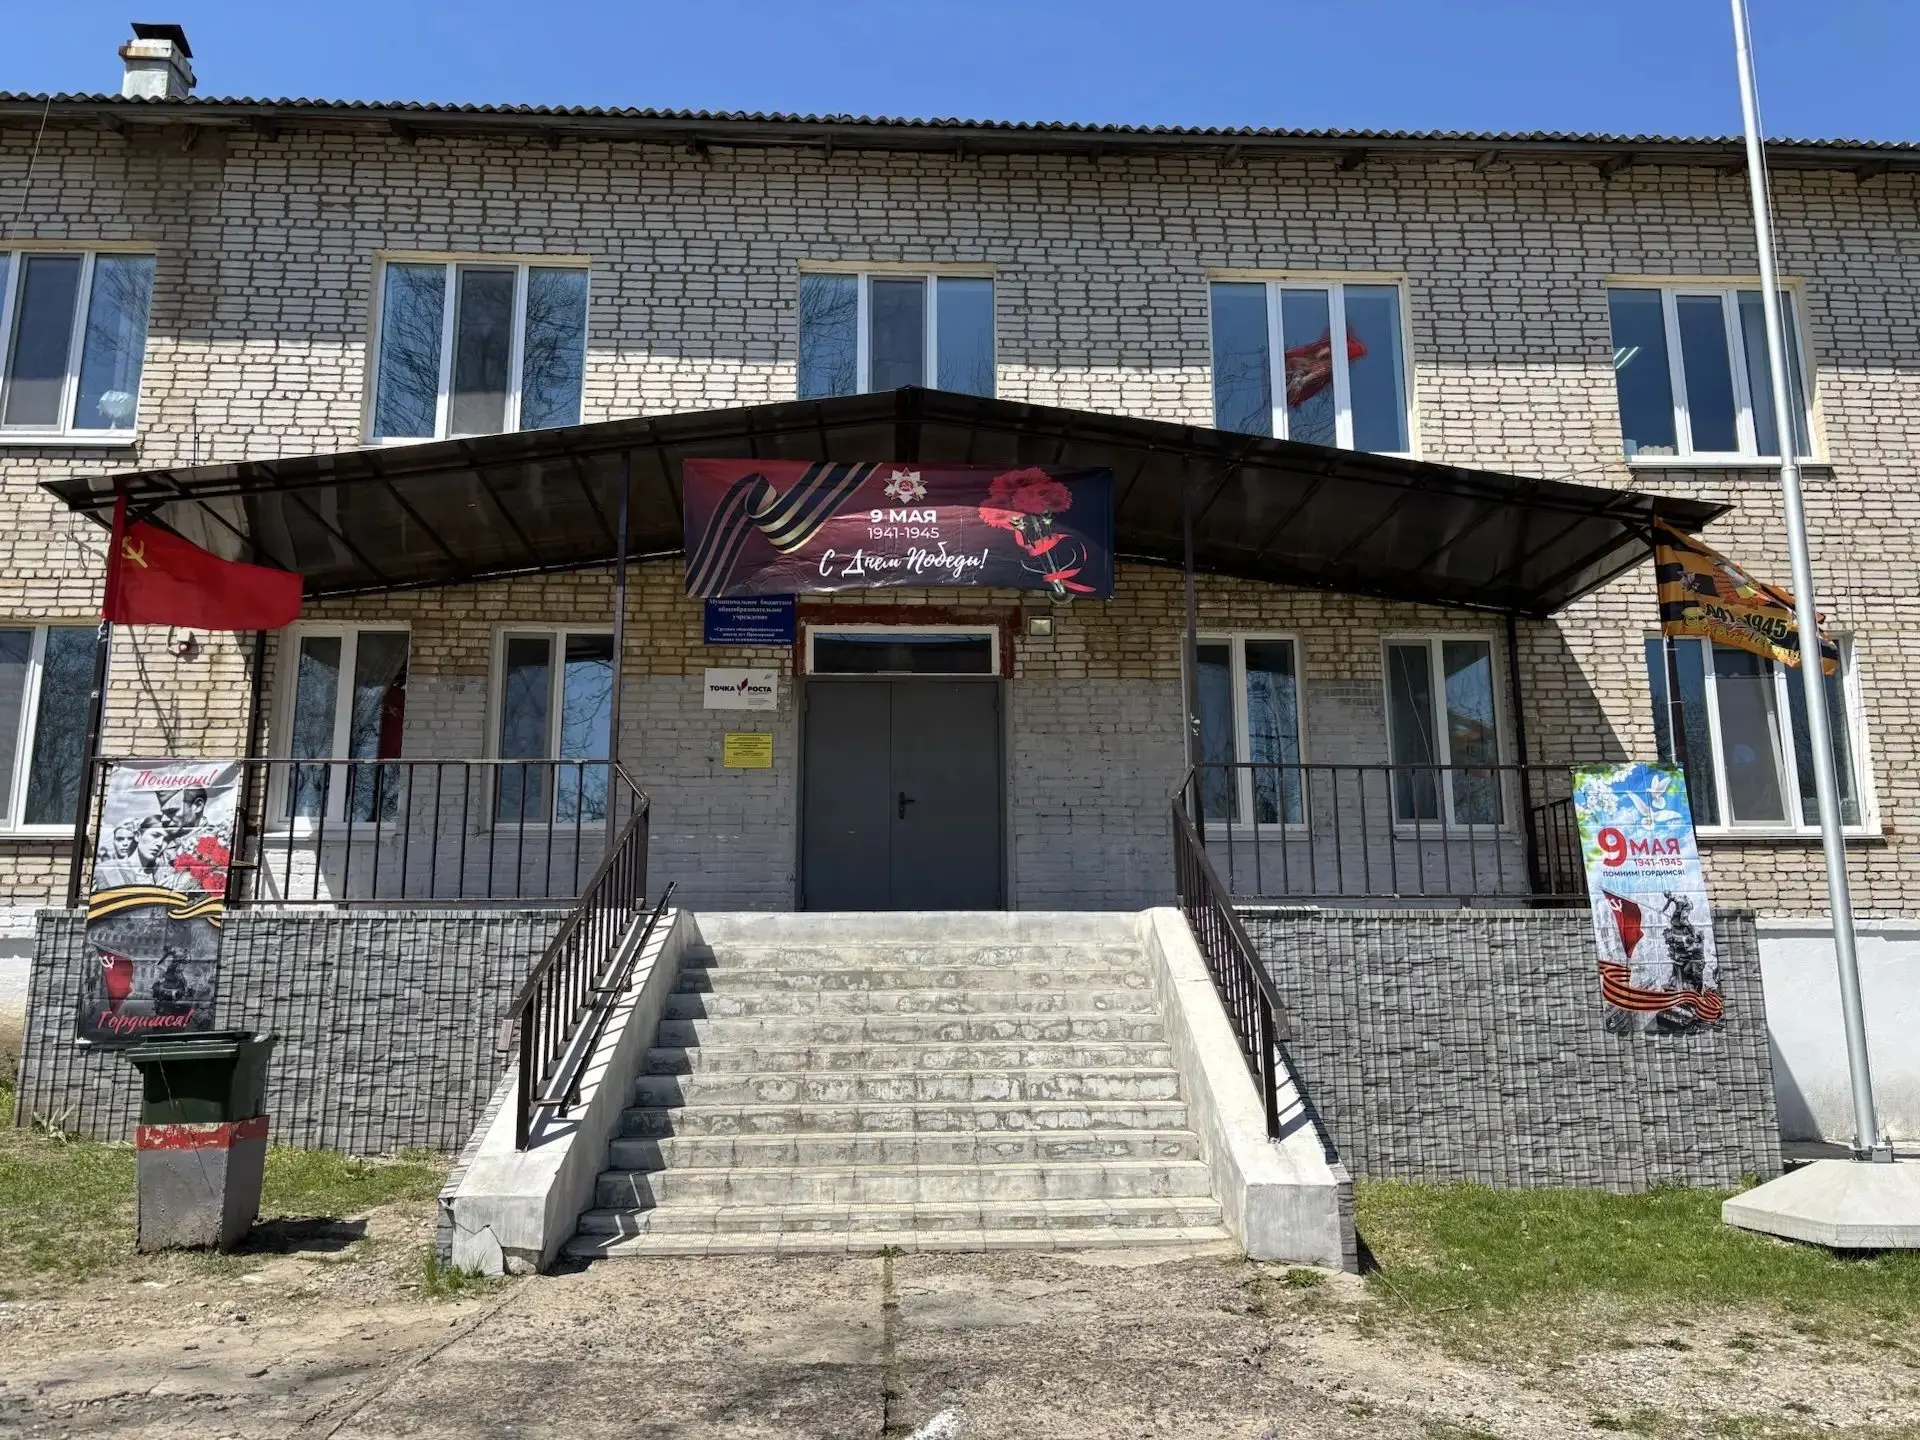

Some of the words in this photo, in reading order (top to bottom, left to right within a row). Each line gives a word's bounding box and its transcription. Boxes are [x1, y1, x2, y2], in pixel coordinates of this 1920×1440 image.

[870, 509, 883, 523] 9
[889, 509, 937, 523] МАЯ
[867, 527, 940, 539] 1941-1945
[818, 548, 836, 577] С
[841, 548, 902, 577] Днем
[906, 540, 989, 579] Победы!
[135, 768, 218, 787] Помним!
[1597, 827, 1628, 867] 9
[1629, 838, 1680, 855] МАЯ
[1633, 858, 1683, 867] 1941-1945
[97, 1007, 196, 1035] Гордимся!
